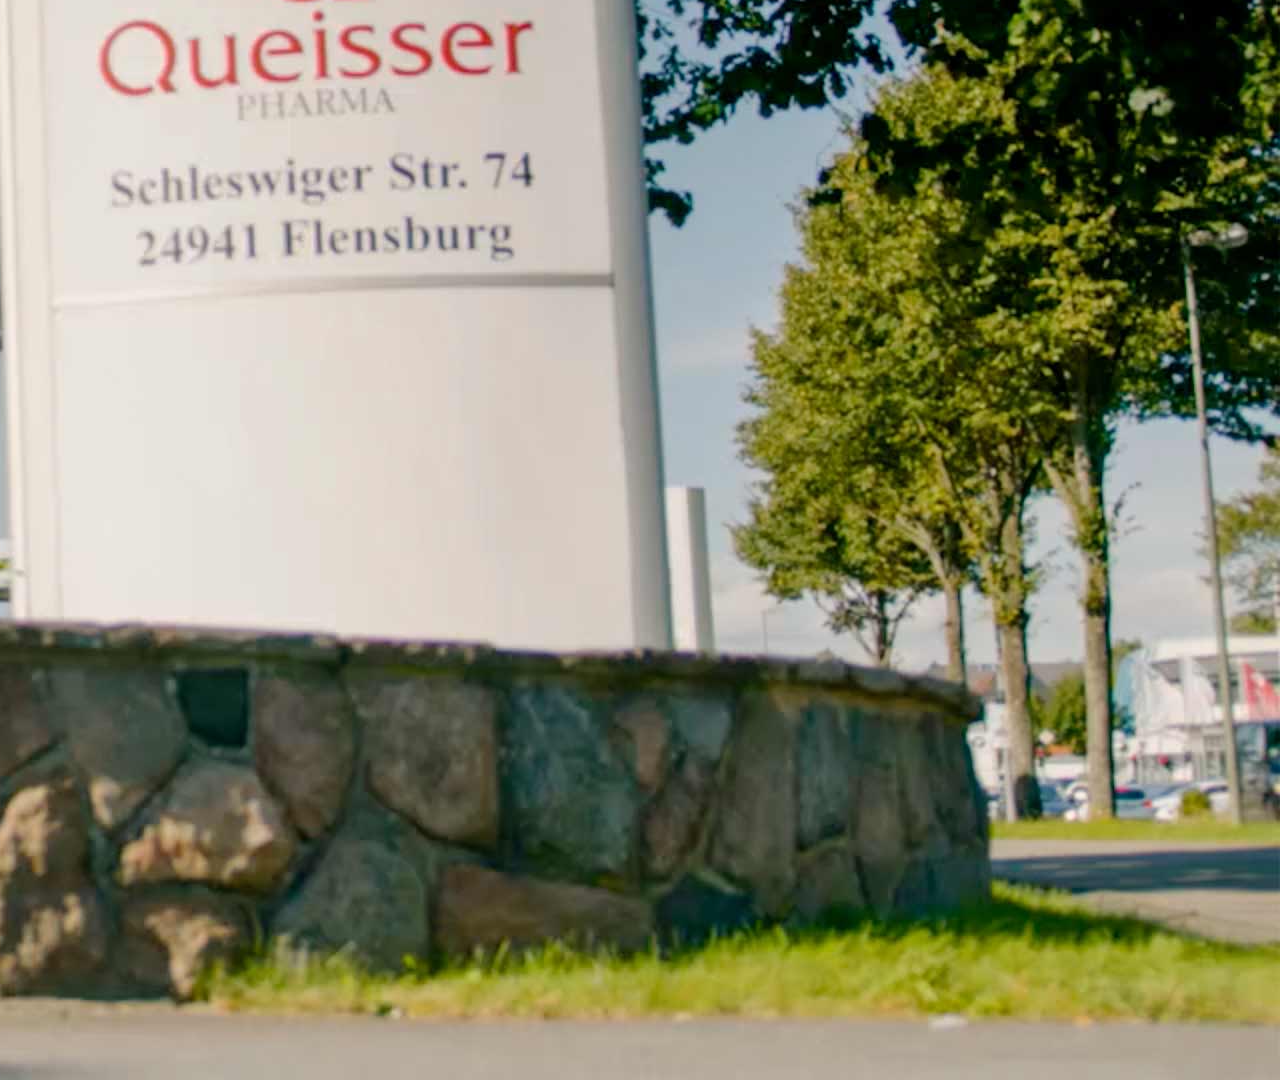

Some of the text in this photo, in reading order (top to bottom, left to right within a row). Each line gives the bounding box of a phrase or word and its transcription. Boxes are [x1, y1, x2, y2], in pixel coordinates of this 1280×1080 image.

[98, 10, 535, 98] Queisser
[236, 86, 397, 121] PHARMA
[110, 151, 535, 208] Schleswiger Str. 74
[136, 216, 516, 267] 24941 Flensburg
